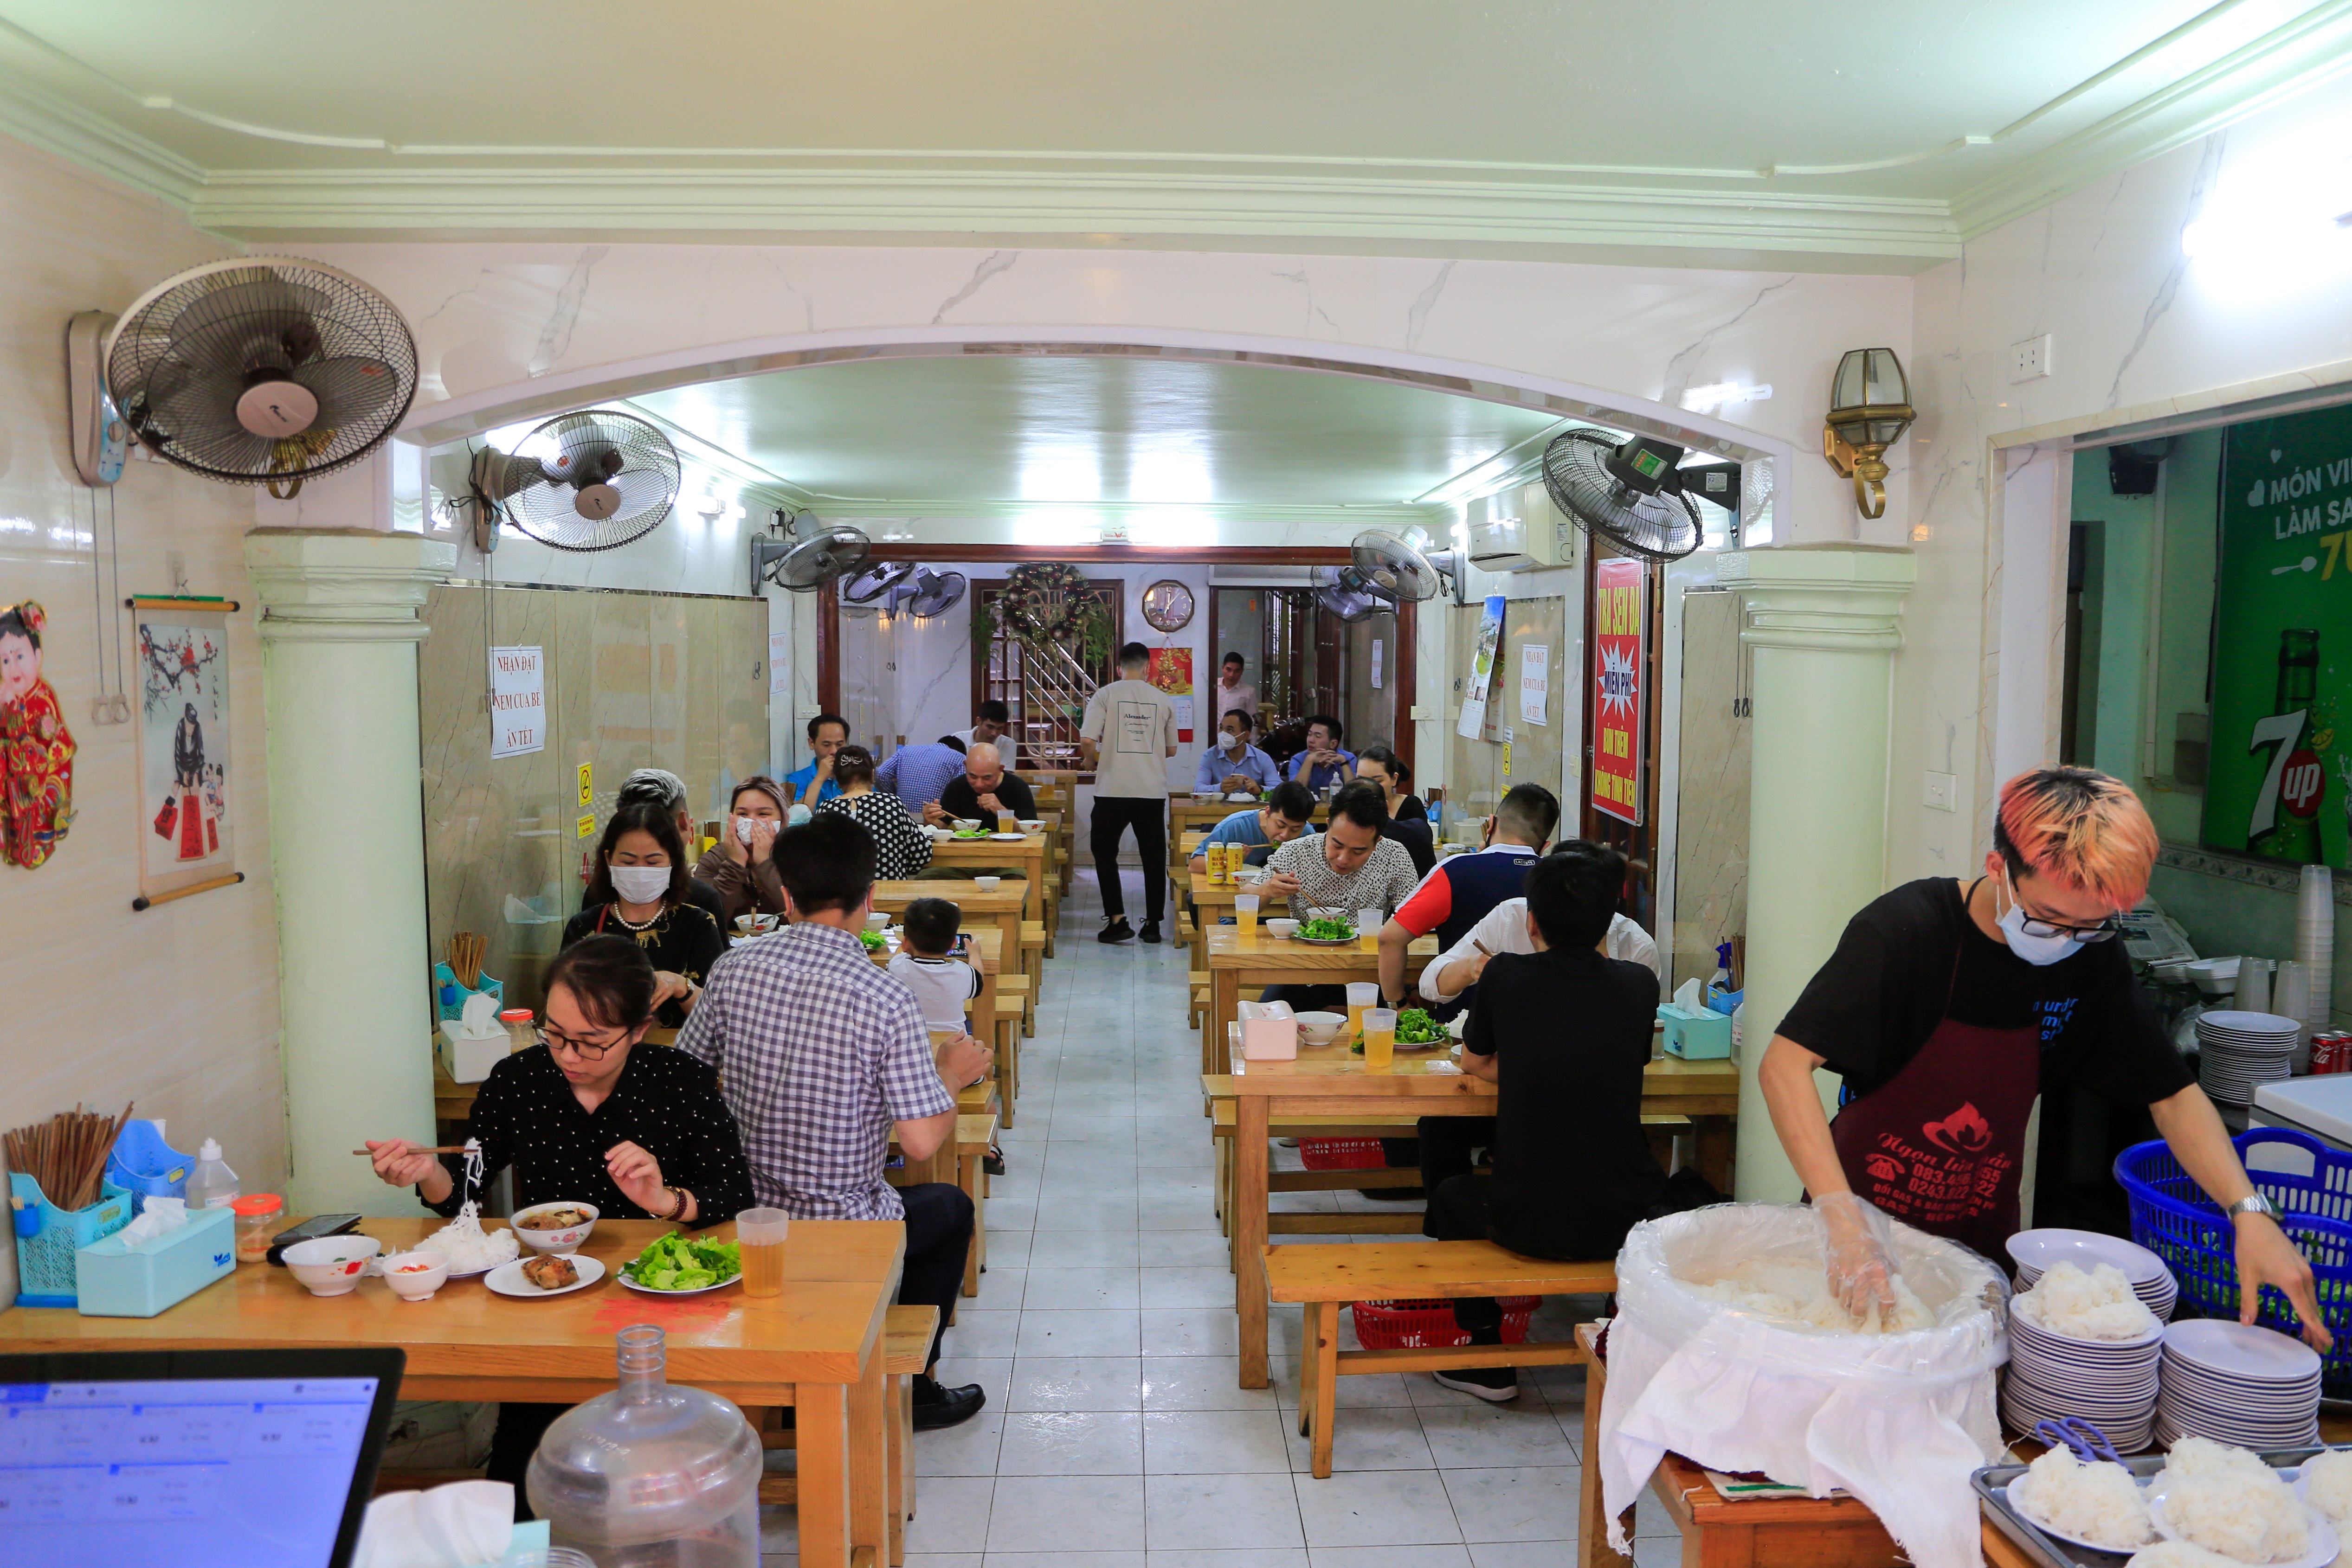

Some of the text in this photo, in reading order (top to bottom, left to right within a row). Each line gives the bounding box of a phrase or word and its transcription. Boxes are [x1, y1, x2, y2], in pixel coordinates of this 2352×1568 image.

[2271, 456, 2352, 504] MÓN VI
[2275, 505, 2321, 540] LÀM
[1599, 574, 1640, 636] TRÀ SEN ĐÁ
[497, 654, 536, 675] NHẬN ĐẶT
[1605, 662, 1632, 697] MIỄN PHÍ
[494, 694, 513, 711] NEM
[514, 693, 530, 708] CUA
[506, 725, 534, 748] ĂN TẾT
[1603, 724, 1629, 759] BÚN THÊM
[1594, 765, 1636, 808] KHÔNG TÍNH TIỀN
[1874, 1196, 1909, 1214] GAS
[1892, 1189, 1913, 1204] GAS
